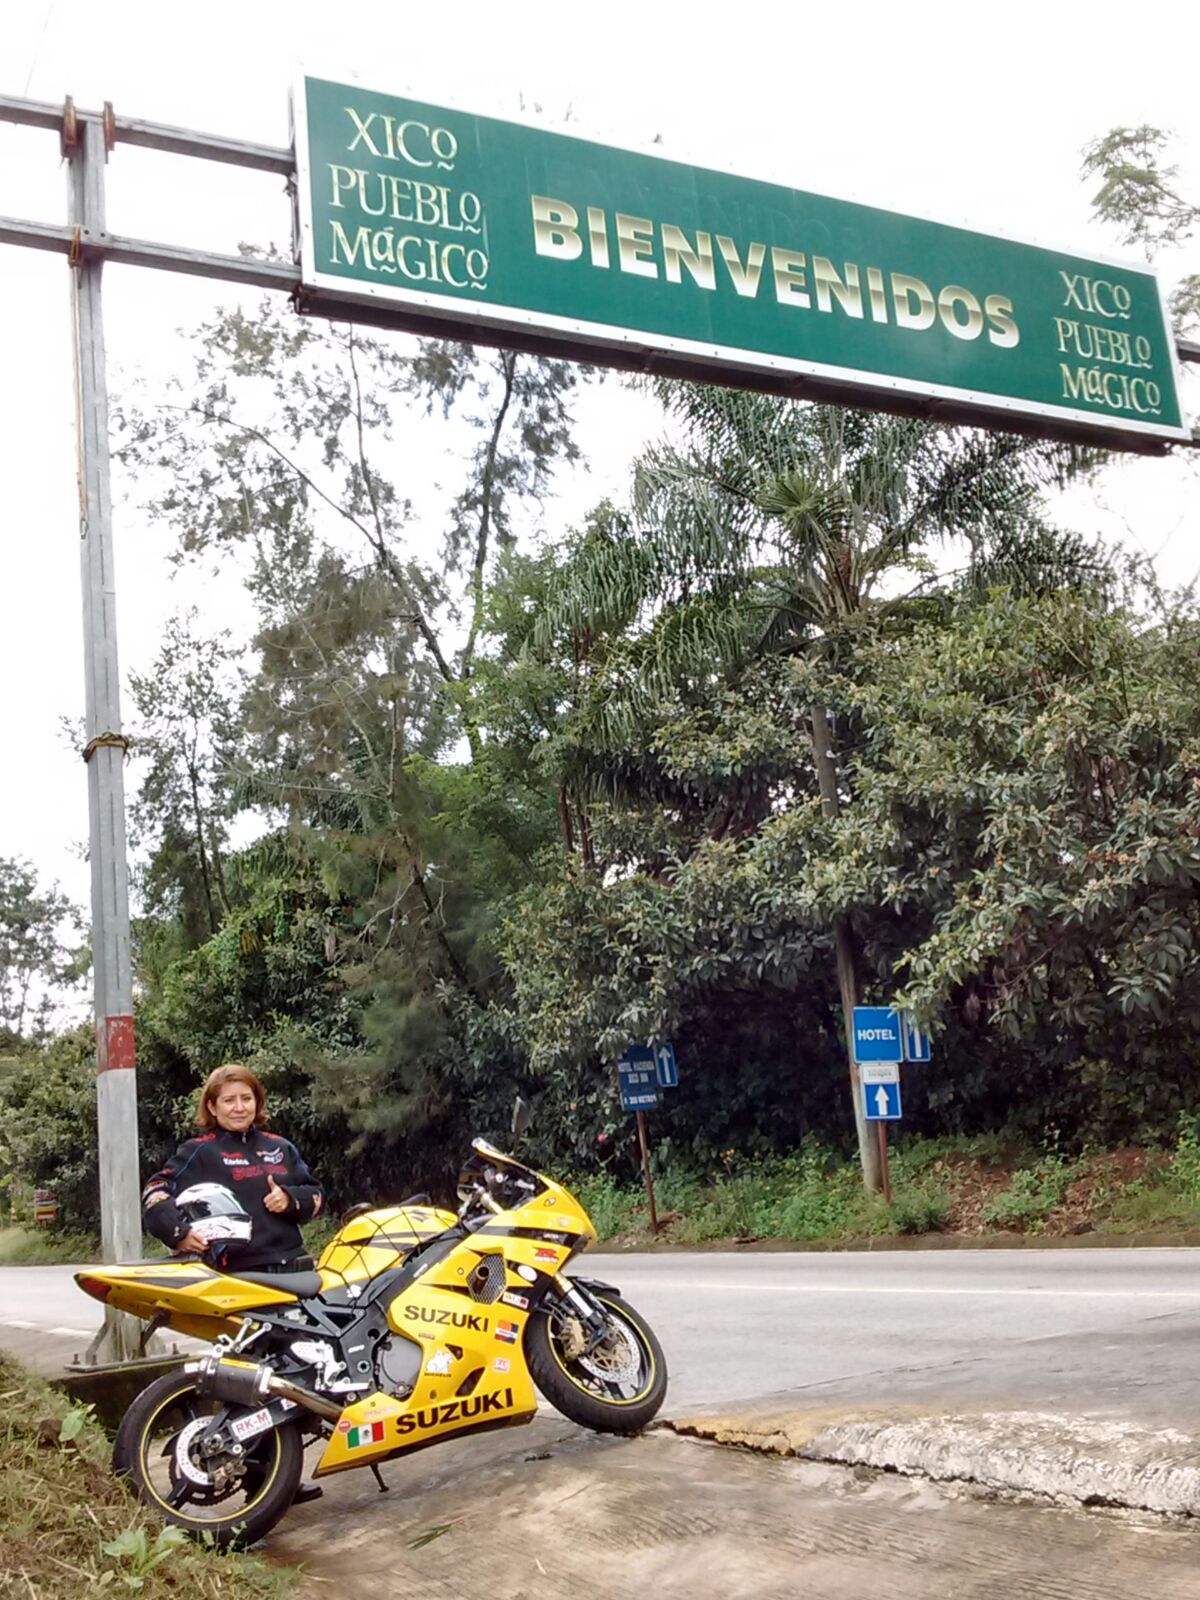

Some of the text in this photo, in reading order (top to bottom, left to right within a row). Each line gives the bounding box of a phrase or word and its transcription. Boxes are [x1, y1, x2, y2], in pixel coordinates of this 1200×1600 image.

[344, 107, 458, 170] XICO
[327, 163, 481, 234] PUEBLO
[531, 194, 1020, 349] BIENVENIDOS
[1058, 270, 1131, 320] XICO
[1053, 316, 1153, 370] PUEBLO
[857, 1028, 896, 1041] HOTEL
[404, 1304, 489, 1332] SUZUKI
[395, 1387, 514, 1435] SUZUKI
